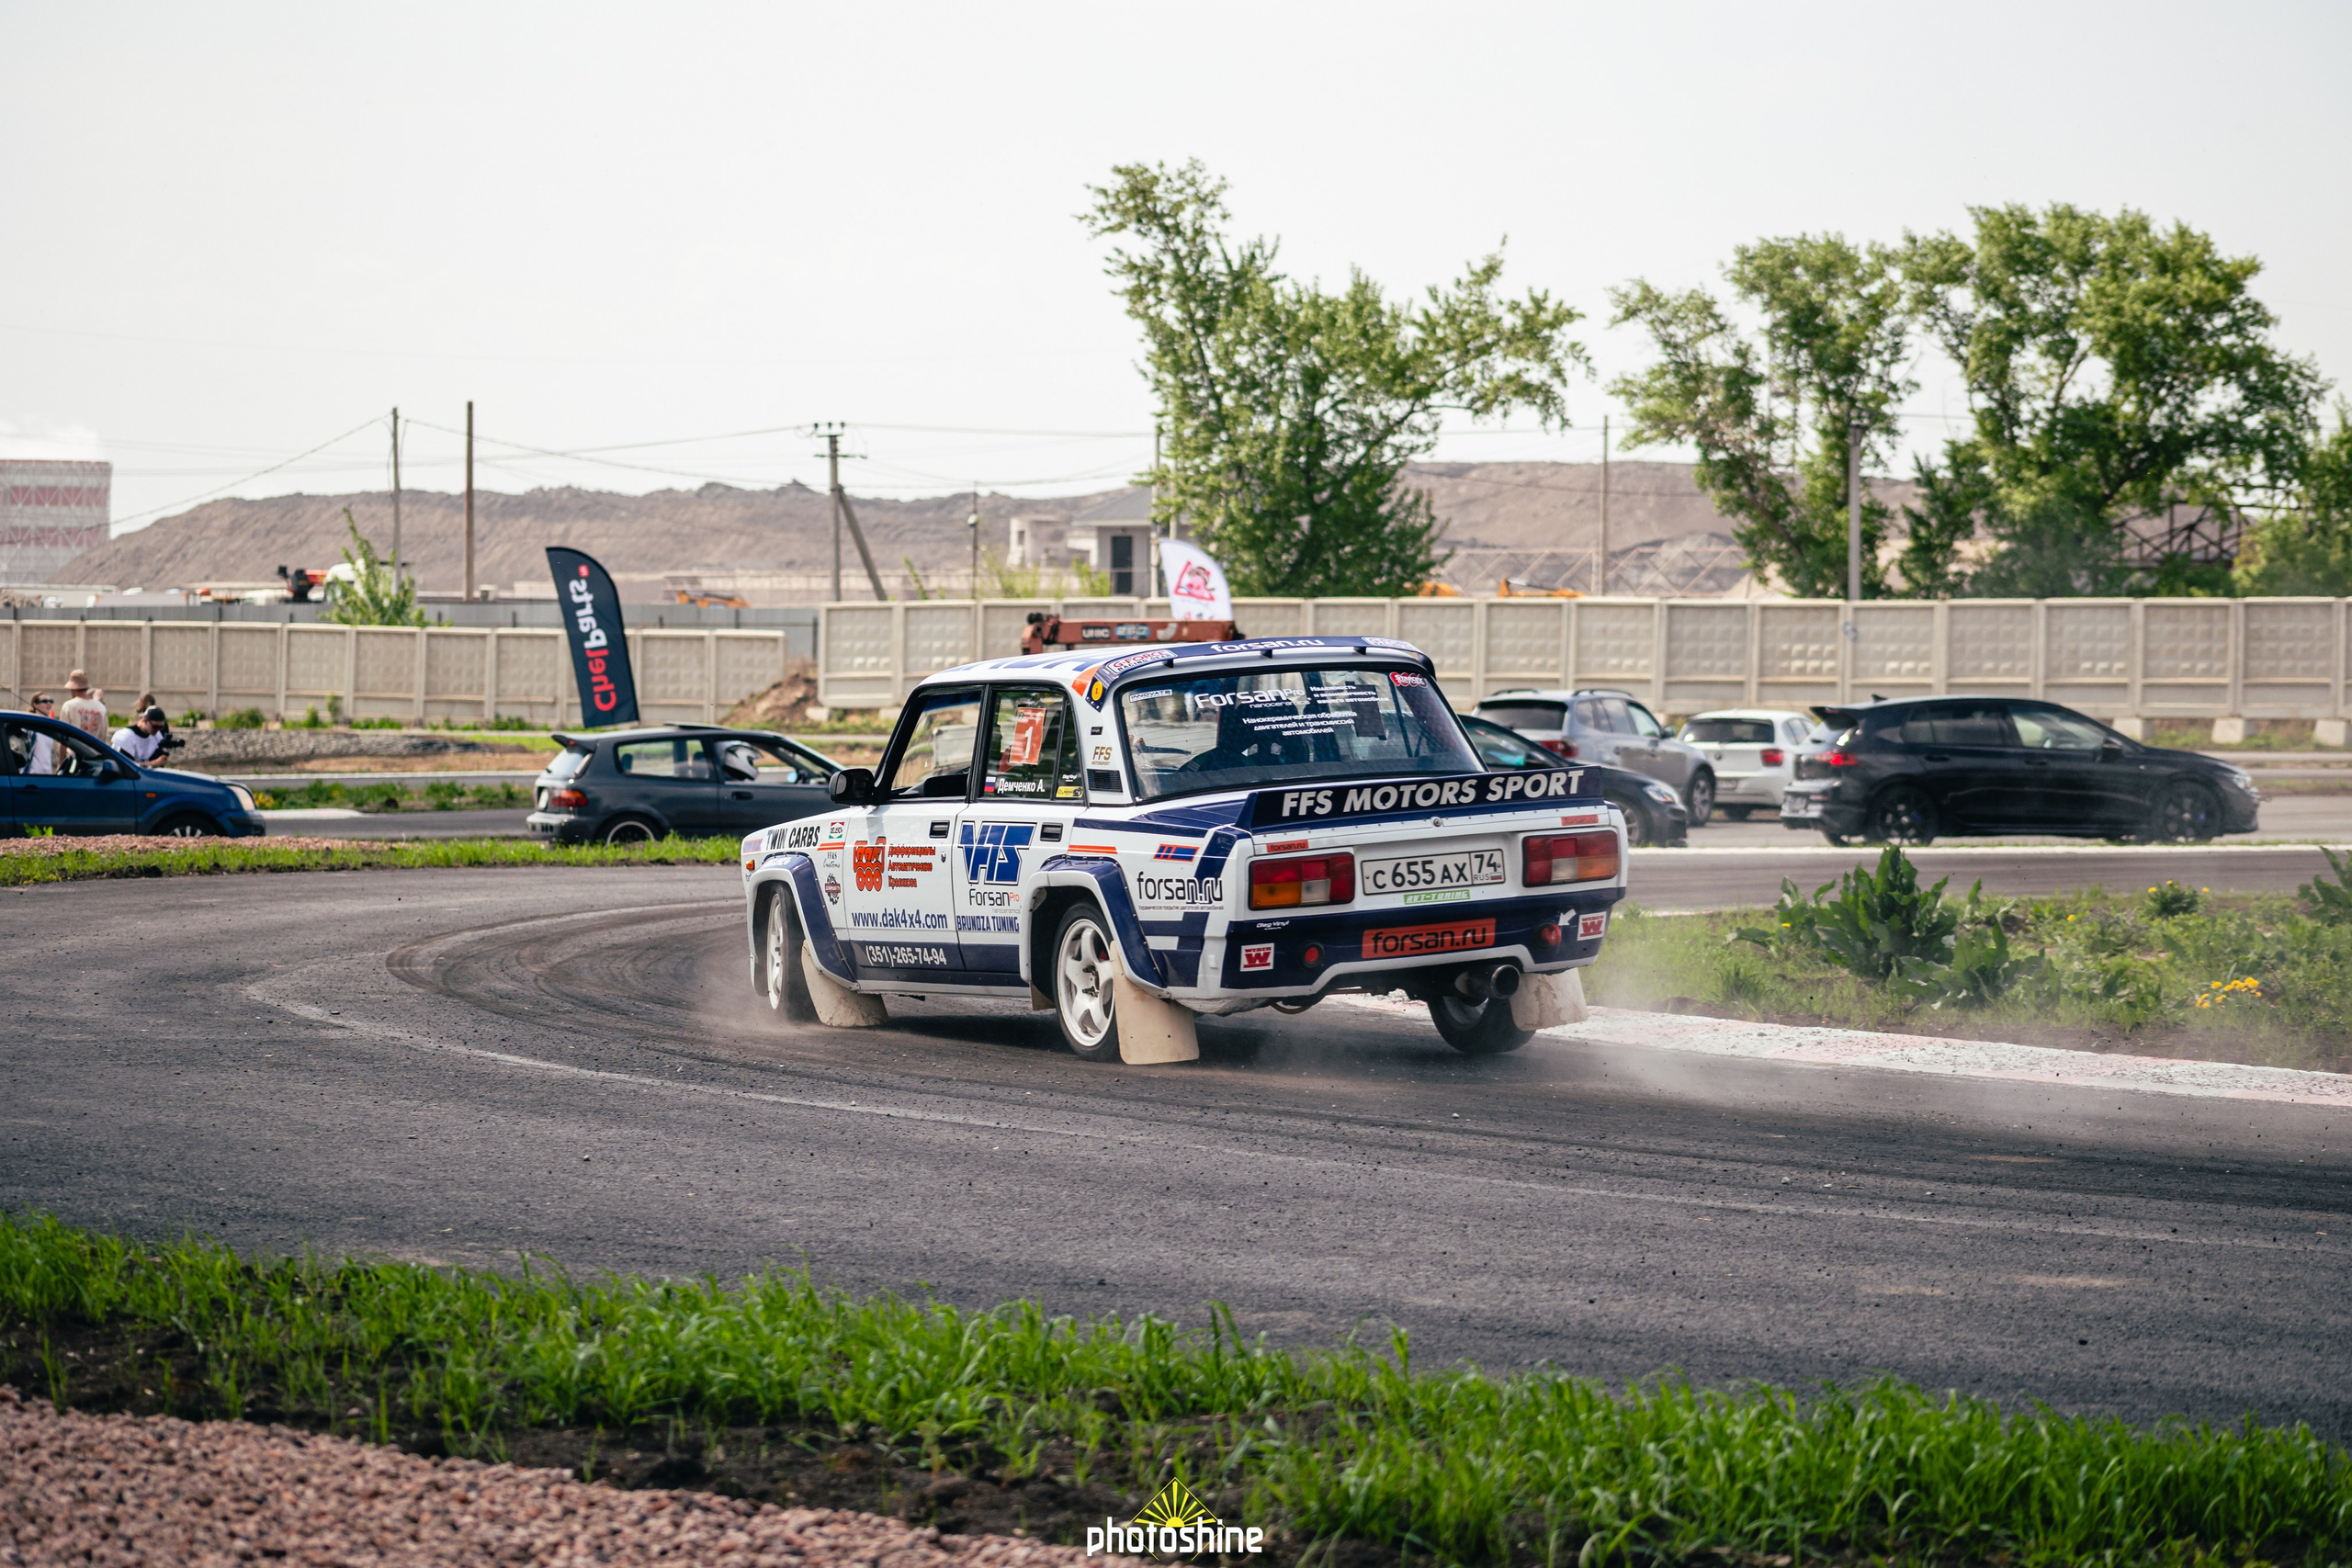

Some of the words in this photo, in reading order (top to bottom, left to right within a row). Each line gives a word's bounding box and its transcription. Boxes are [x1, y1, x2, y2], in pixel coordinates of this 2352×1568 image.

[1209, 637, 1325, 654] forsan.ru
[1131, 691, 1170, 700] INNOVATE
[1282, 727, 1334, 736] автомобилей
[1024, 726, 1034, 759] 1
[1092, 746, 1113, 761] FFS
[997, 778, 1036, 794] Демченко
[1282, 790, 1333, 817] FFS
[1342, 778, 1477, 813] MOTORS
[1486, 769, 1585, 802] SPORT
[765, 828, 788, 851] TWIN
[788, 825, 820, 849] CARBS
[888, 843, 936, 858] Дифференциалы
[888, 859, 933, 872] Автоматические
[1473, 852, 1497, 874] 74
[1473, 873, 1490, 882] RUS
[1136, 871, 1223, 902] forsan.ru
[851, 908, 948, 930] www.dak4x4.com
[956, 915, 991, 931] BRUNDZA
[991, 915, 1020, 932] TUNING
[1373, 926, 1487, 953] forsan.ru
[865, 945, 947, 967] (351)-265-74-94
